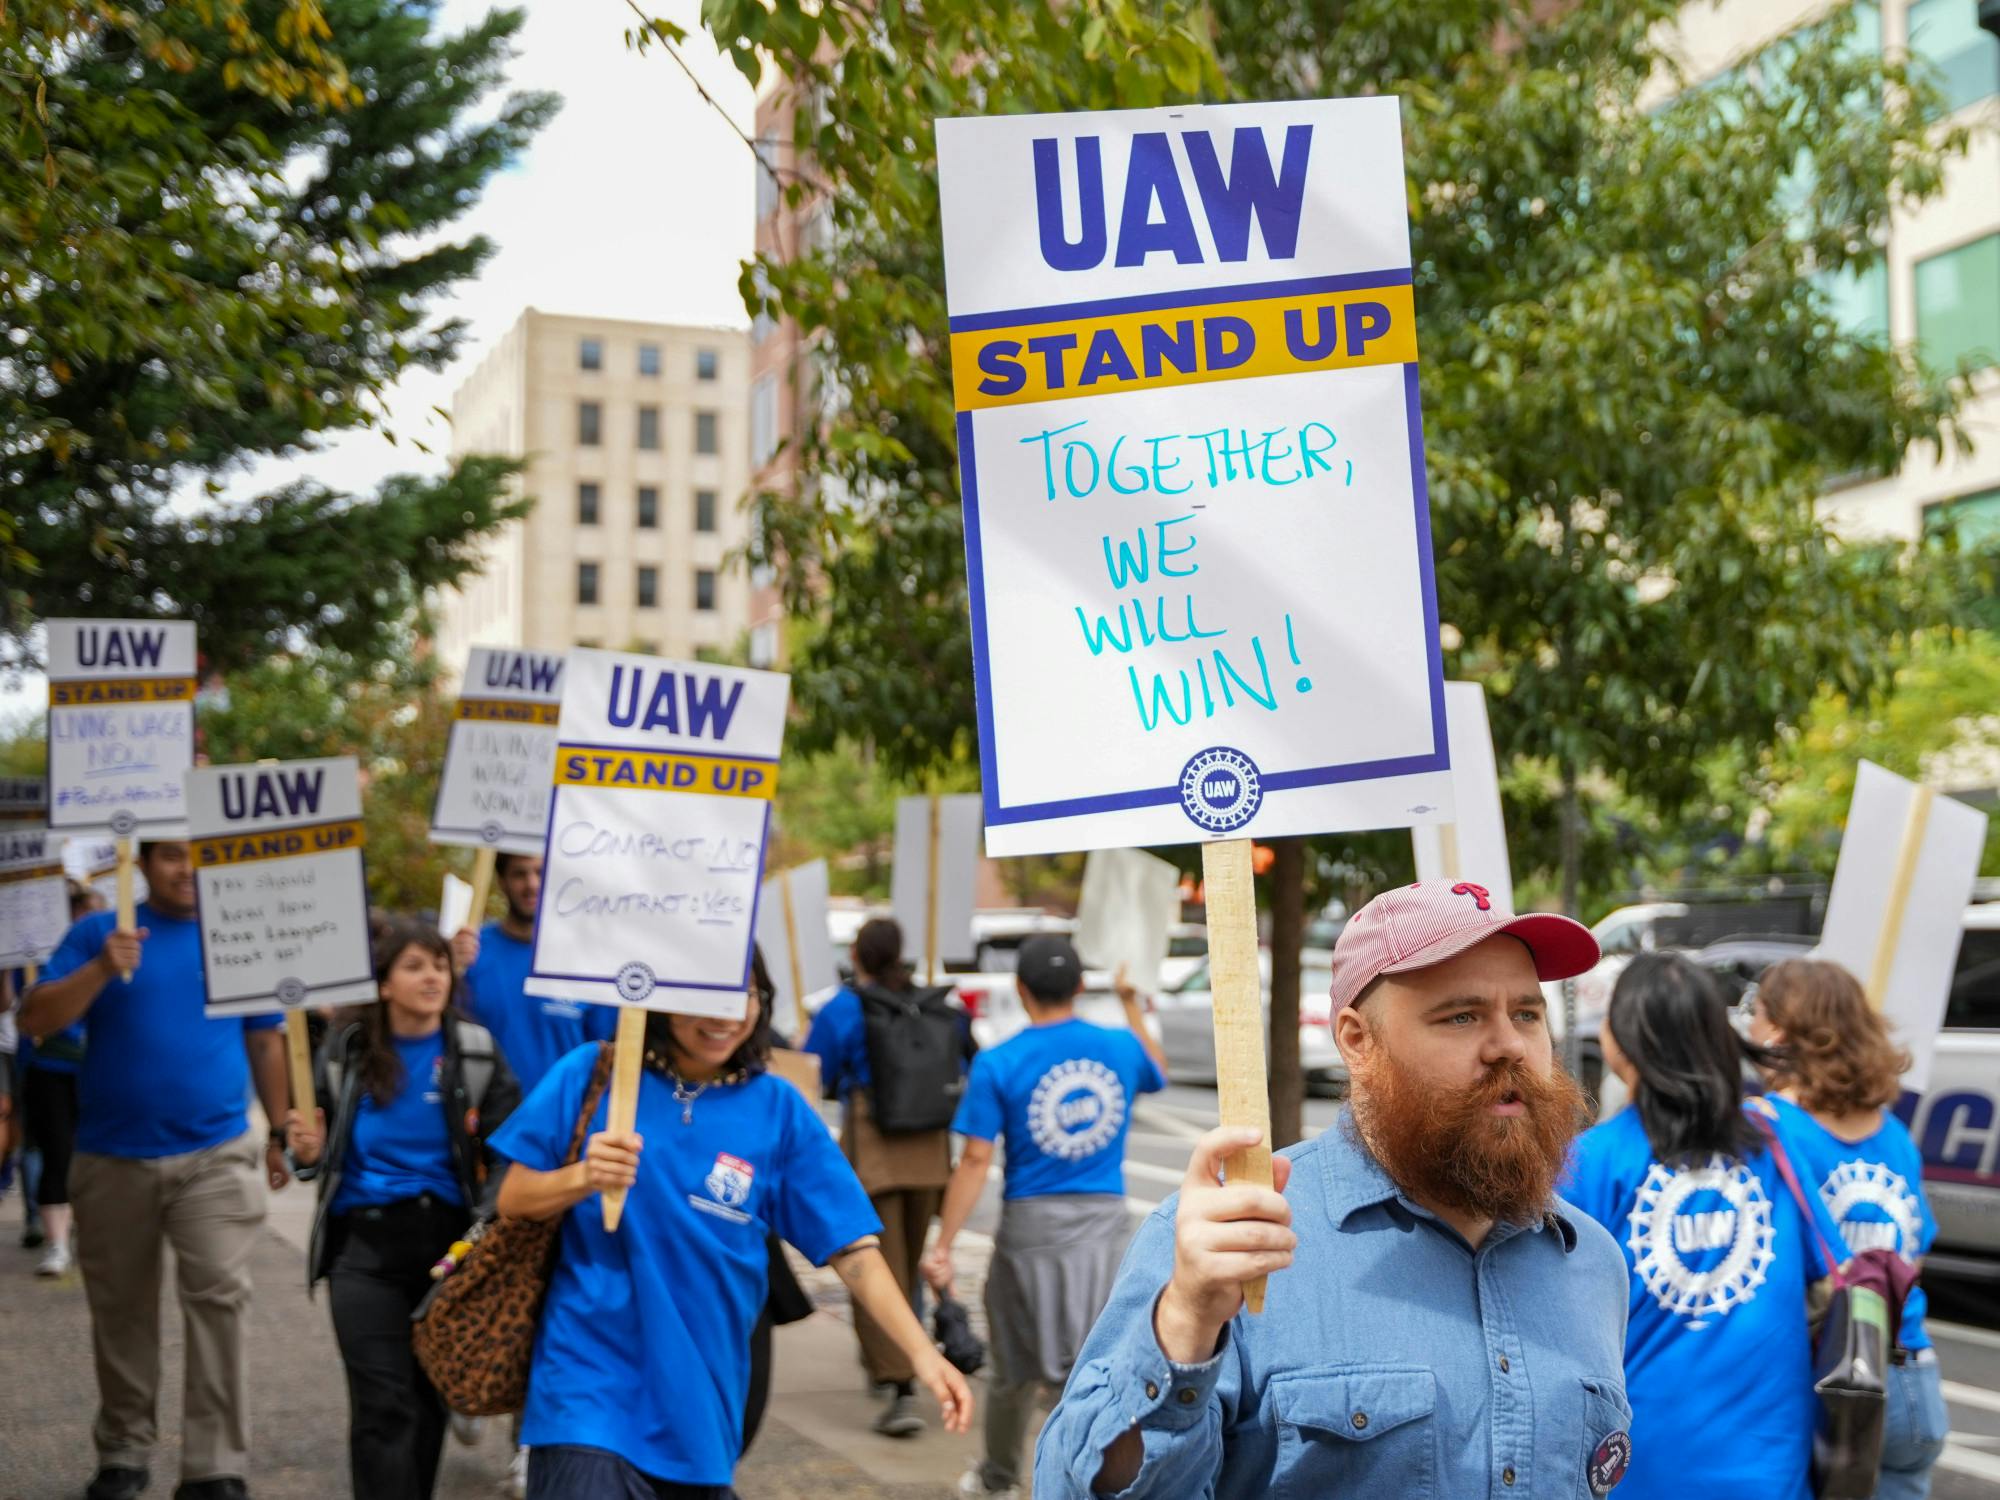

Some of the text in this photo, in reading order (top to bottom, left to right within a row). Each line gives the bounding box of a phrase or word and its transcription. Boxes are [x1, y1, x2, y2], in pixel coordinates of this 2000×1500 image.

[1032, 124, 1314, 272] UAW
[977, 301, 1391, 396] STAND UP
[1019, 419, 1354, 501] TOGETHER,
[1102, 514, 1199, 590] WE
[77, 626, 166, 669] UAW
[1075, 594, 1228, 656] WILL
[55, 682, 186, 703] STAND UP
[485, 649, 564, 692] UAW
[1127, 613, 1312, 731] WIN!
[606, 662, 746, 742] UAW
[219, 768, 324, 821] UAW
[565, 756, 765, 793] STAND UP
[1204, 780, 1236, 799] UAW
[201, 828, 356, 864] STAND UP
[1673, 1209, 1737, 1253] UAW
